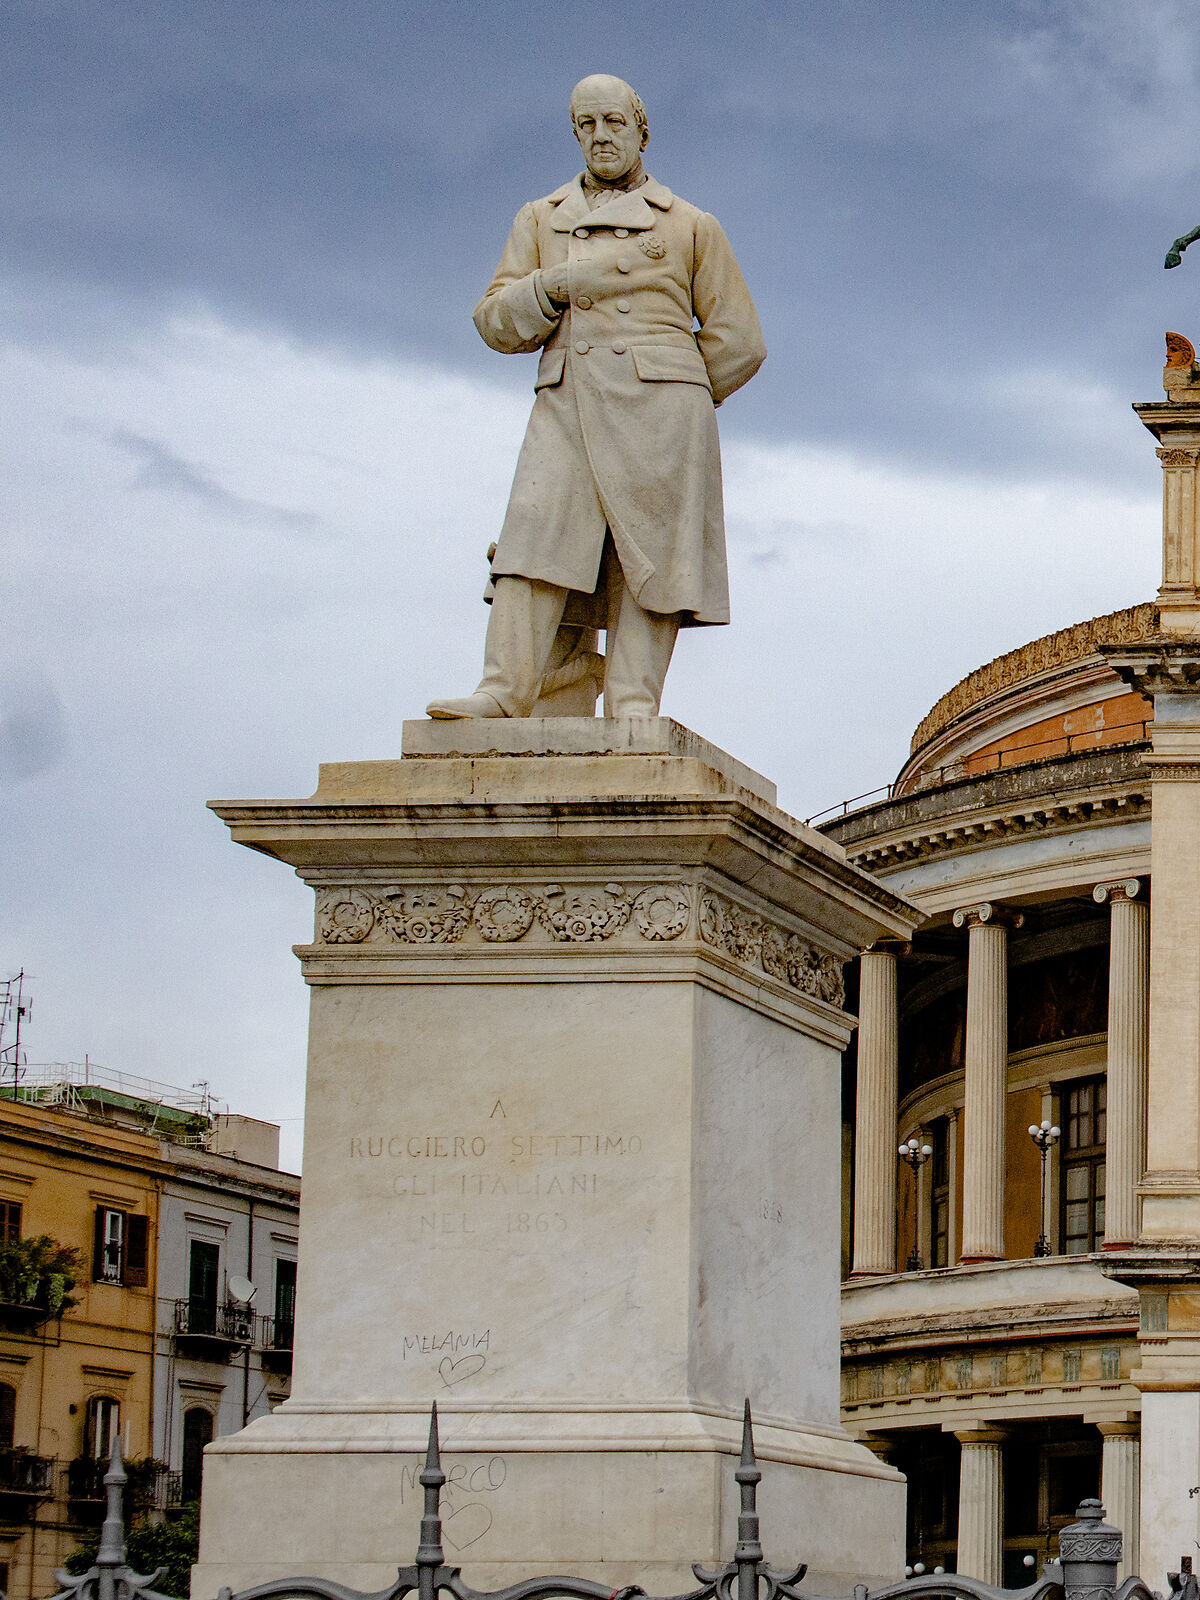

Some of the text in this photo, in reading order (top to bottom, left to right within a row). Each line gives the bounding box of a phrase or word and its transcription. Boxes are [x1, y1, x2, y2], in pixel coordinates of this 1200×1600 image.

[489, 1099, 507, 1119] A
[349, 1135, 643, 1159] RUGGIERO SETTIMO
[392, 1173, 599, 1197] GLI ITALIANI
[421, 1212, 476, 1235] NEL
[402, 1328, 491, 1361] MELANIA
